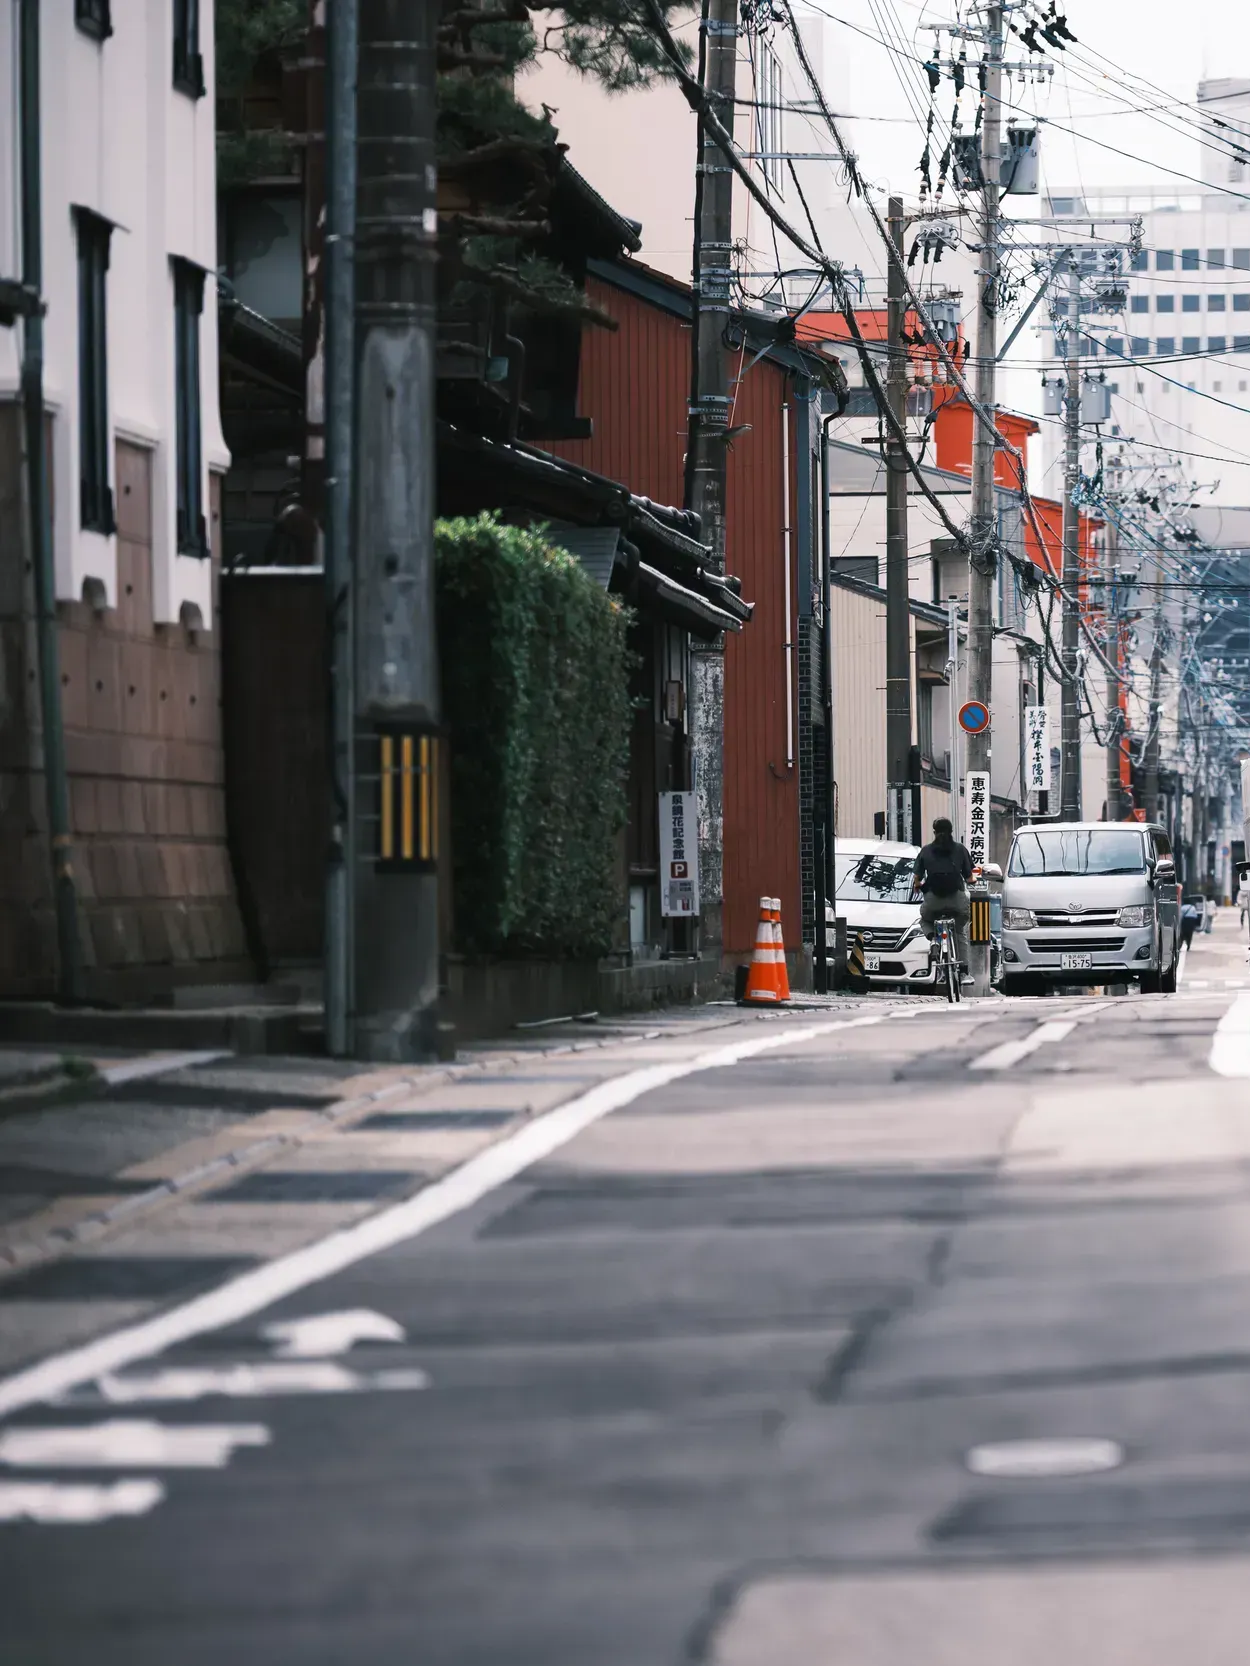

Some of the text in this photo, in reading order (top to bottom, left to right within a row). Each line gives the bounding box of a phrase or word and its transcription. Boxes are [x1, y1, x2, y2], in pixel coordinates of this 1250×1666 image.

[672, 794, 684, 860] 泉鏡花記念館
[971, 777, 985, 865] 恵寿金沢病院
[674, 864, 685, 877] P
[1068, 959, 1090, 968] 15-75
